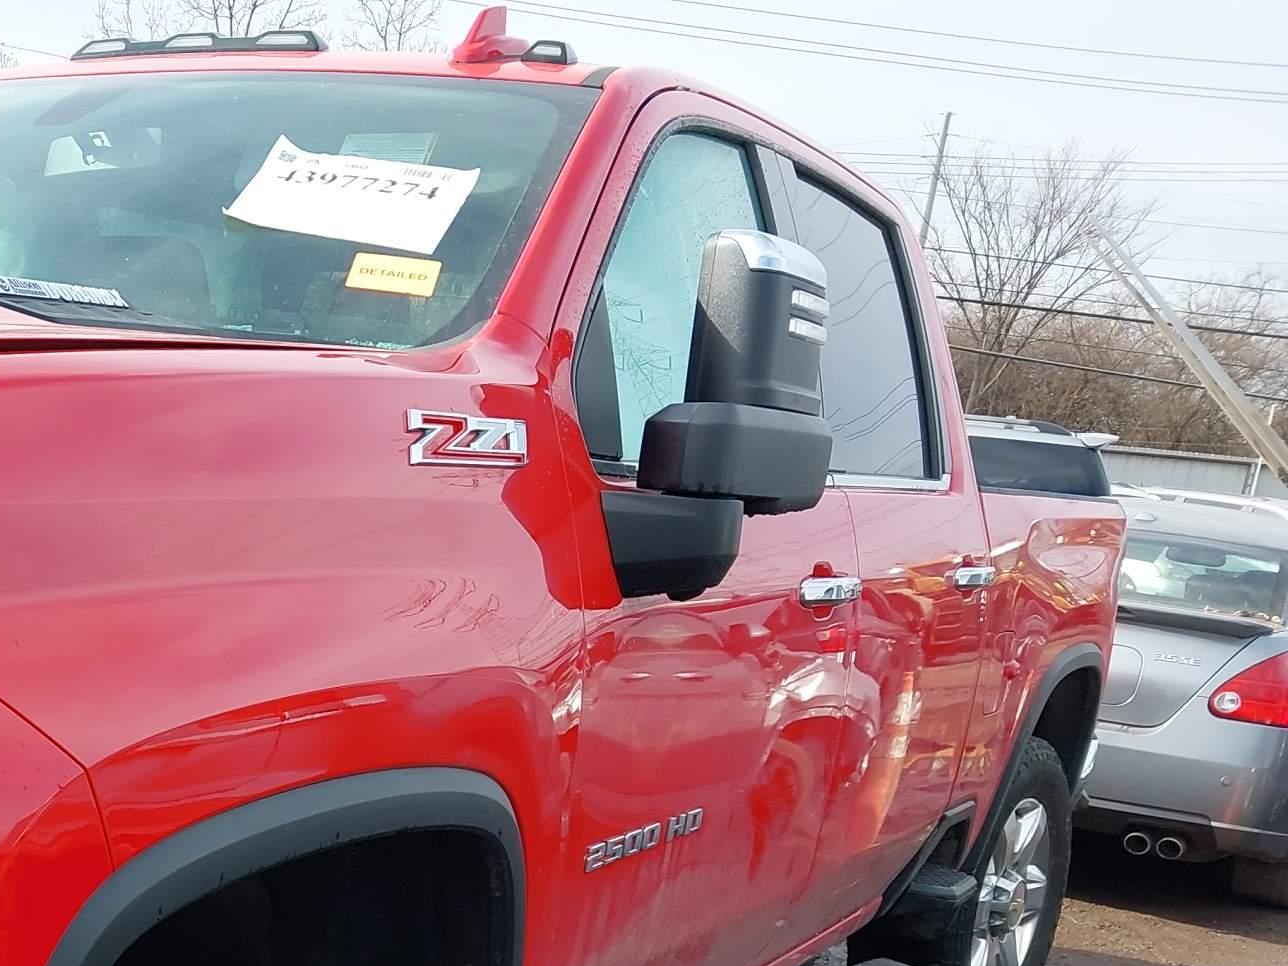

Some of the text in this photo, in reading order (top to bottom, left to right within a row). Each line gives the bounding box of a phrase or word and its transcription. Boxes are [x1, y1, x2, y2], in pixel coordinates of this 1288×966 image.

[276, 169, 440, 200] 43977274
[358, 266, 429, 283] DETAILED
[405, 408, 529, 467] Z71
[583, 807, 704, 873] 2500 HD
